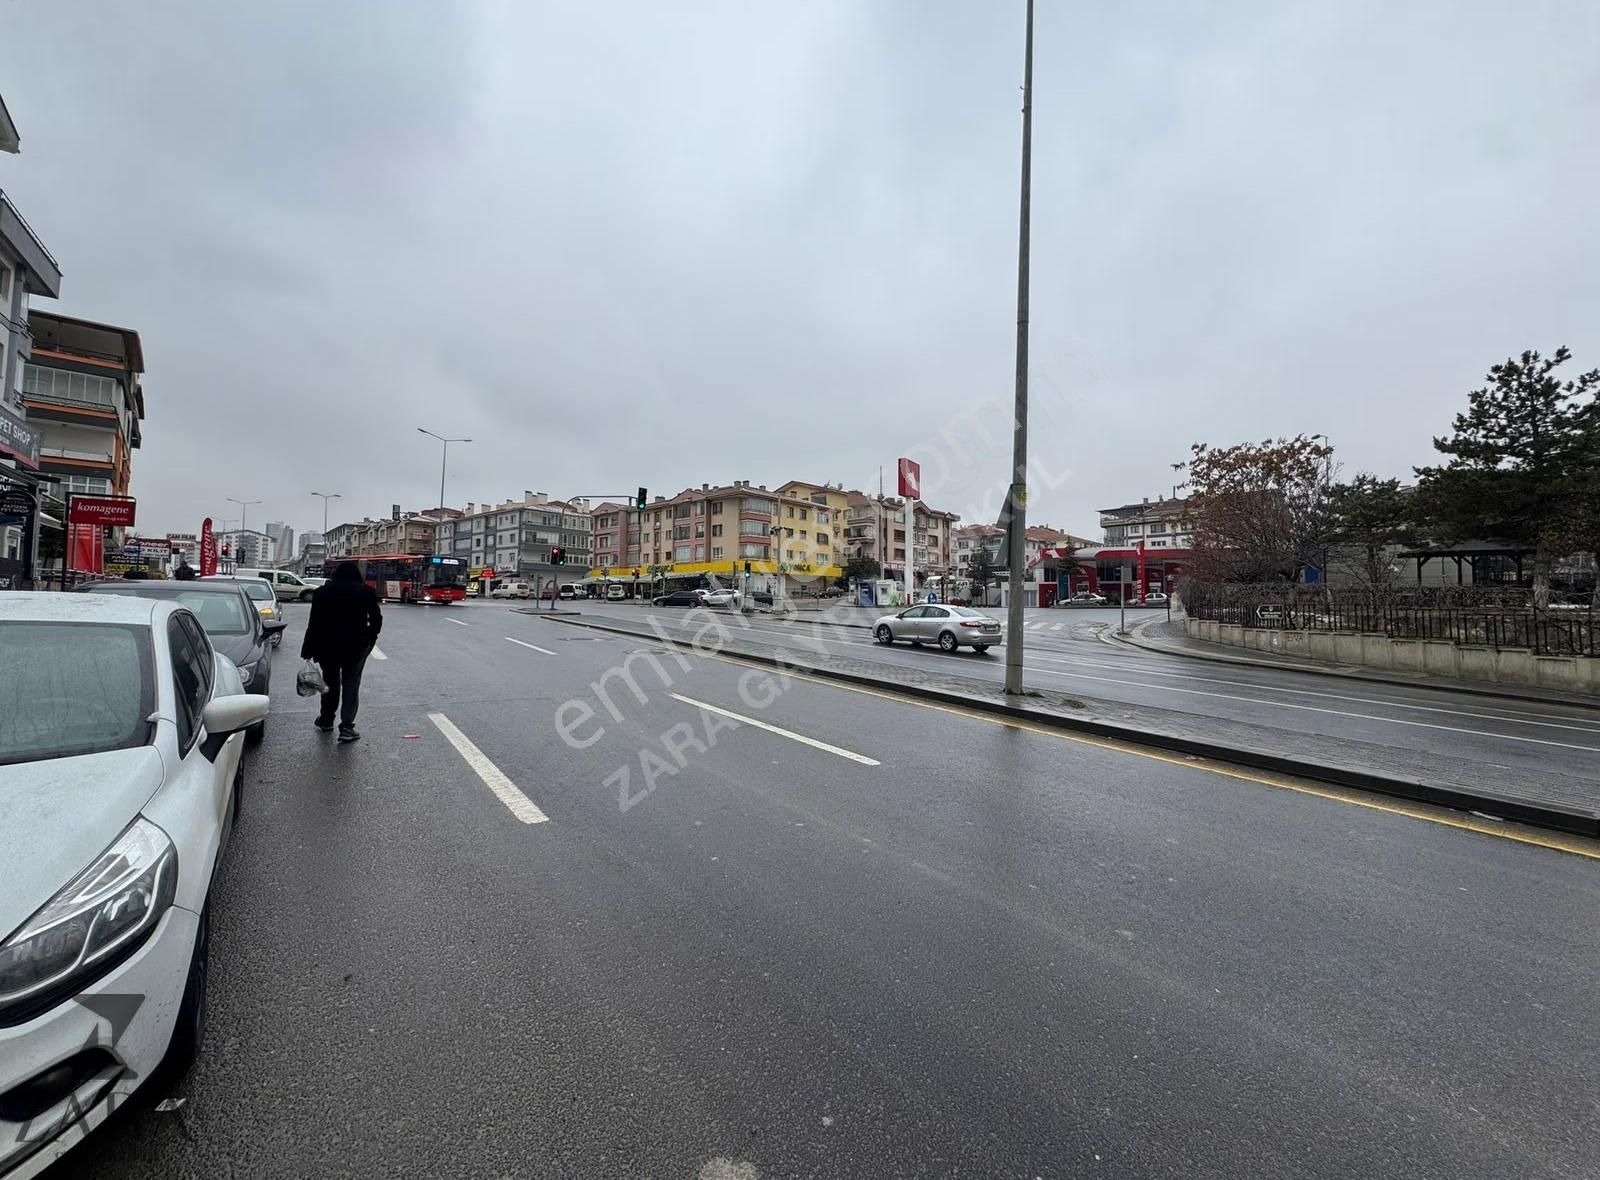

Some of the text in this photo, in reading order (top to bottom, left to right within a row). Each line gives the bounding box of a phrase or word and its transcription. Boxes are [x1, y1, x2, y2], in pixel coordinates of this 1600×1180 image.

[0, 416, 13, 435] PET
[13, 425, 31, 446] SHOP
[77, 502, 129, 515] komagene
